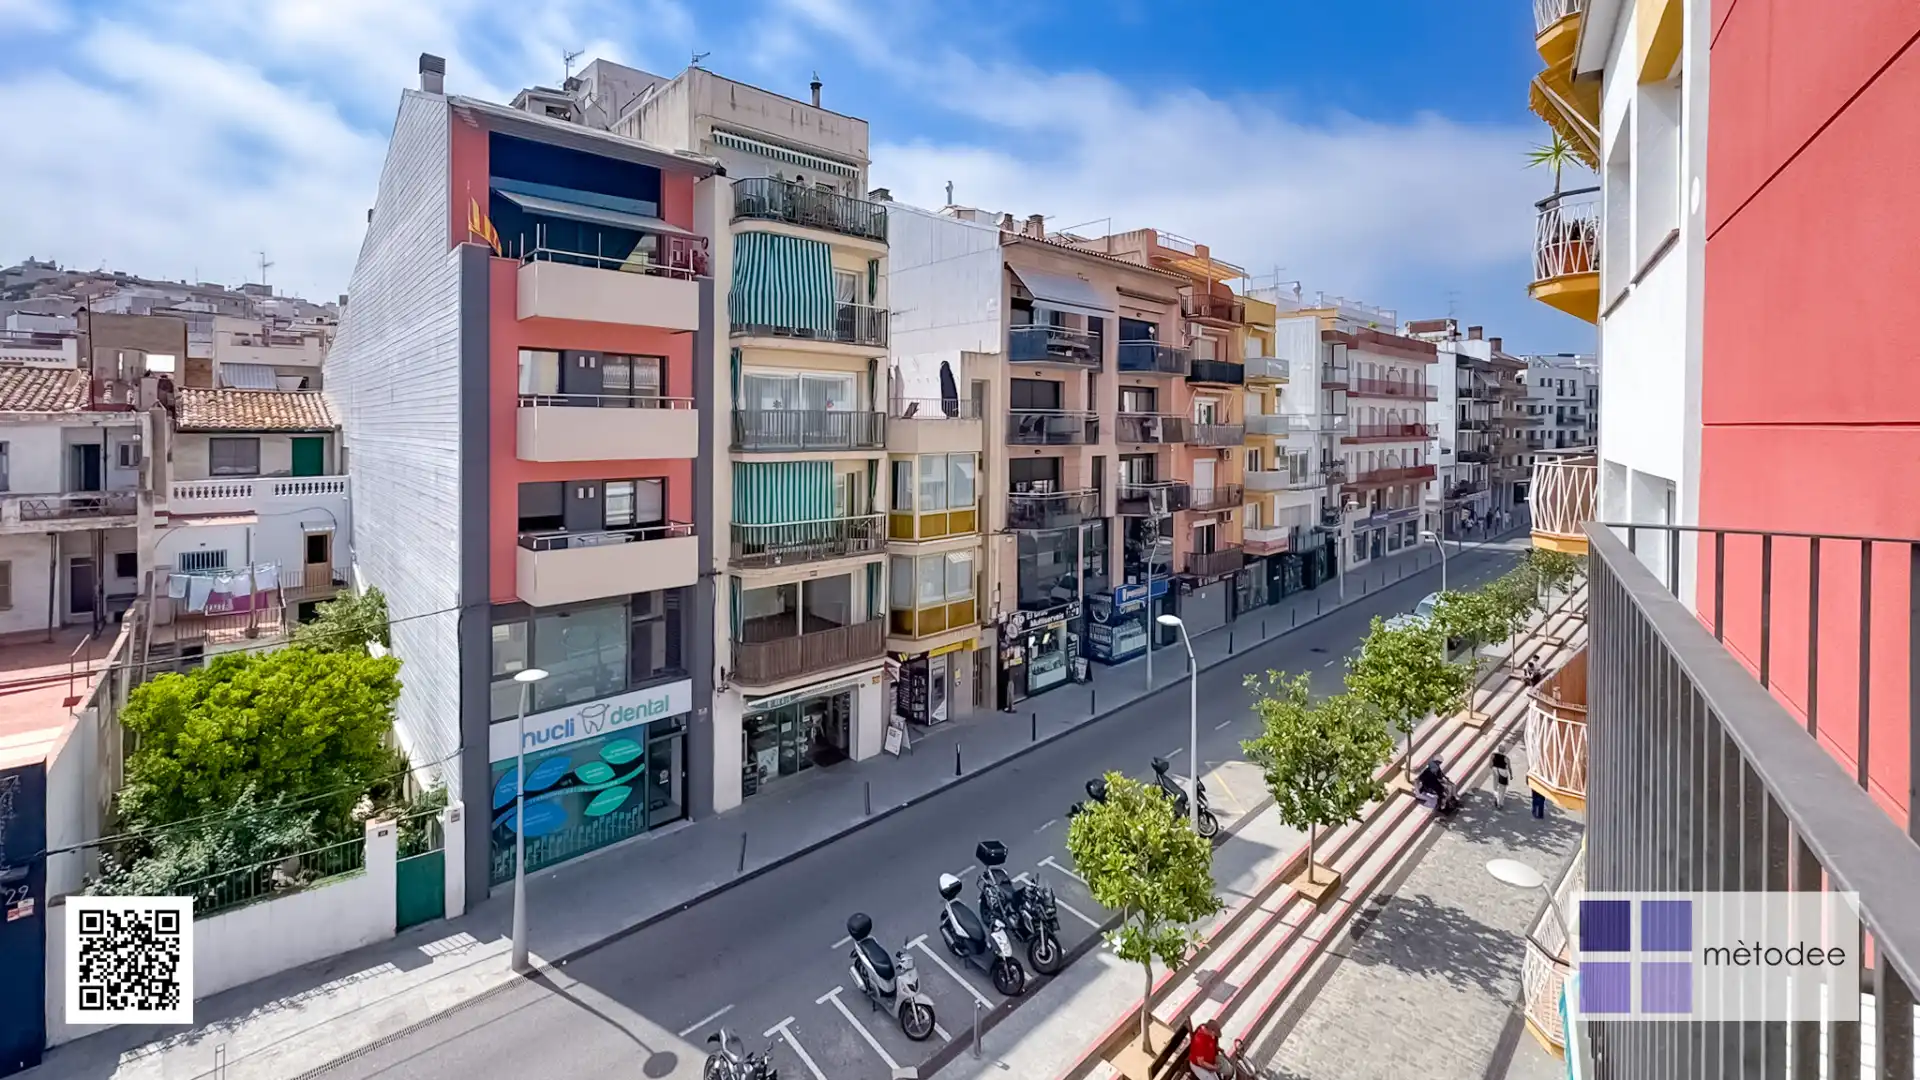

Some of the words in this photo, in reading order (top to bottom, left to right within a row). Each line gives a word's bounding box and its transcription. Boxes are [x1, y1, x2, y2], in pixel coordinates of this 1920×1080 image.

[522, 717, 575, 748] nucli
[610, 695, 670, 725] dental
[5, 885, 29, 906] 29
